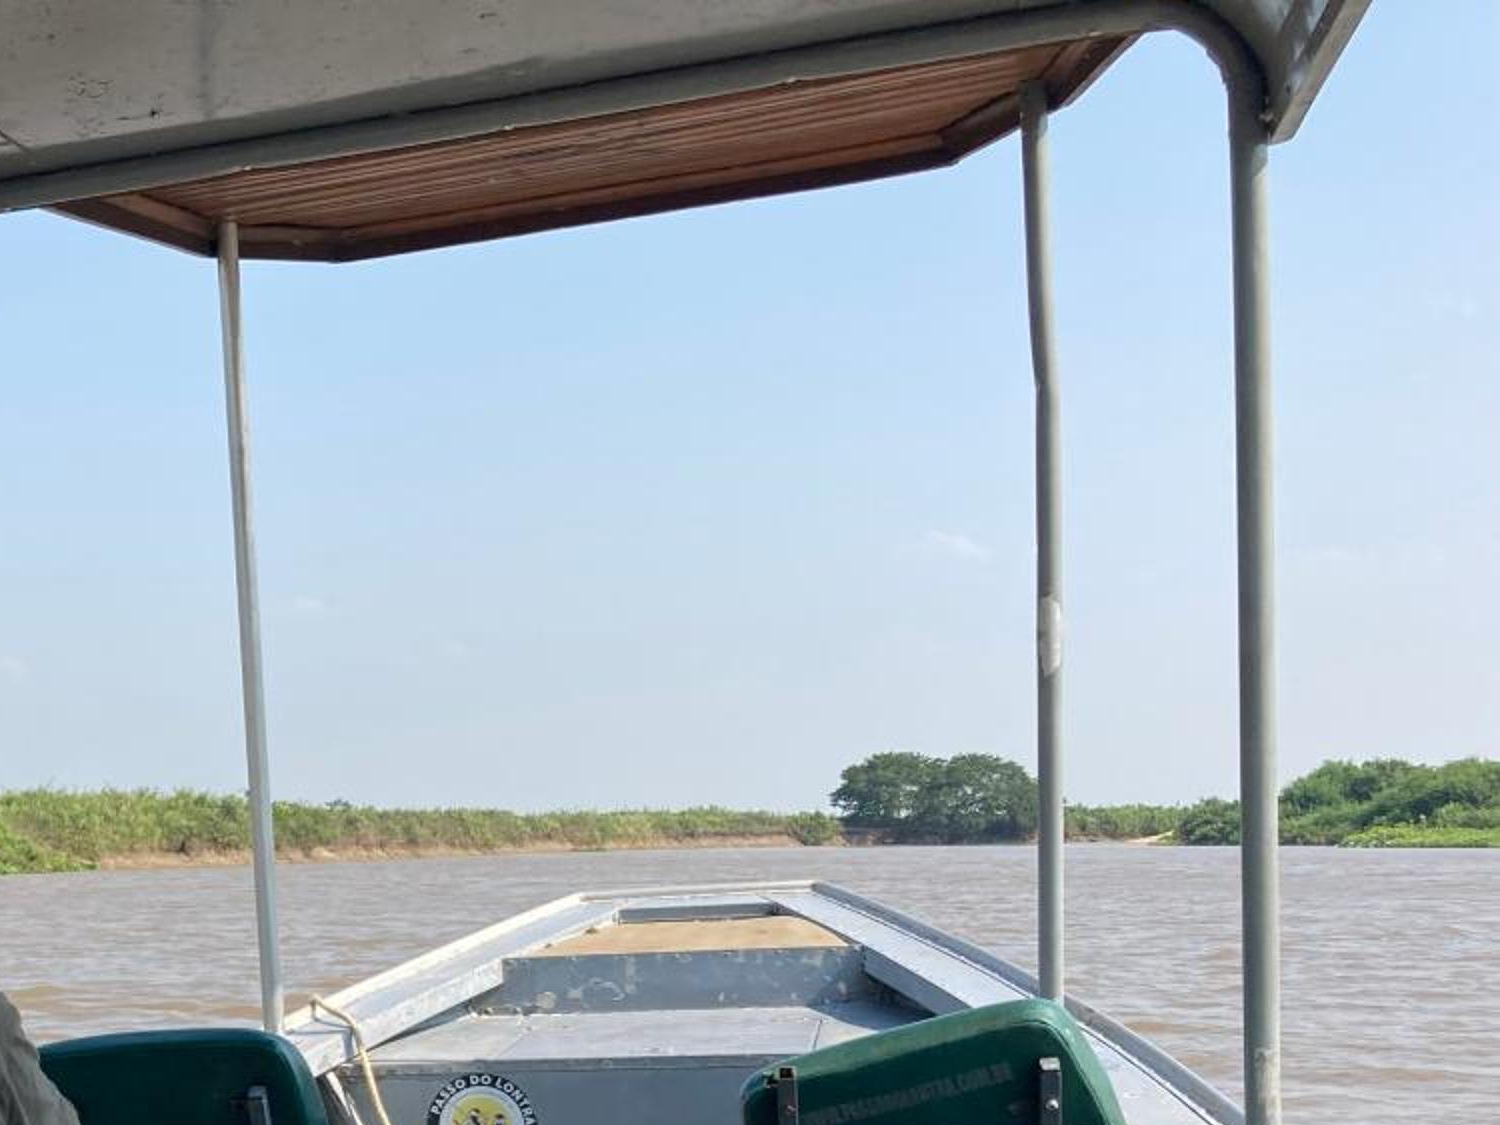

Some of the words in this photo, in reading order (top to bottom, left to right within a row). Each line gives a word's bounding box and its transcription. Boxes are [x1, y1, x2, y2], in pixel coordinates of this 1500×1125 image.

[430, 1079, 466, 1115] PASSO
[469, 1074, 492, 1086] DO
[495, 1077, 537, 1125] LONTRA
